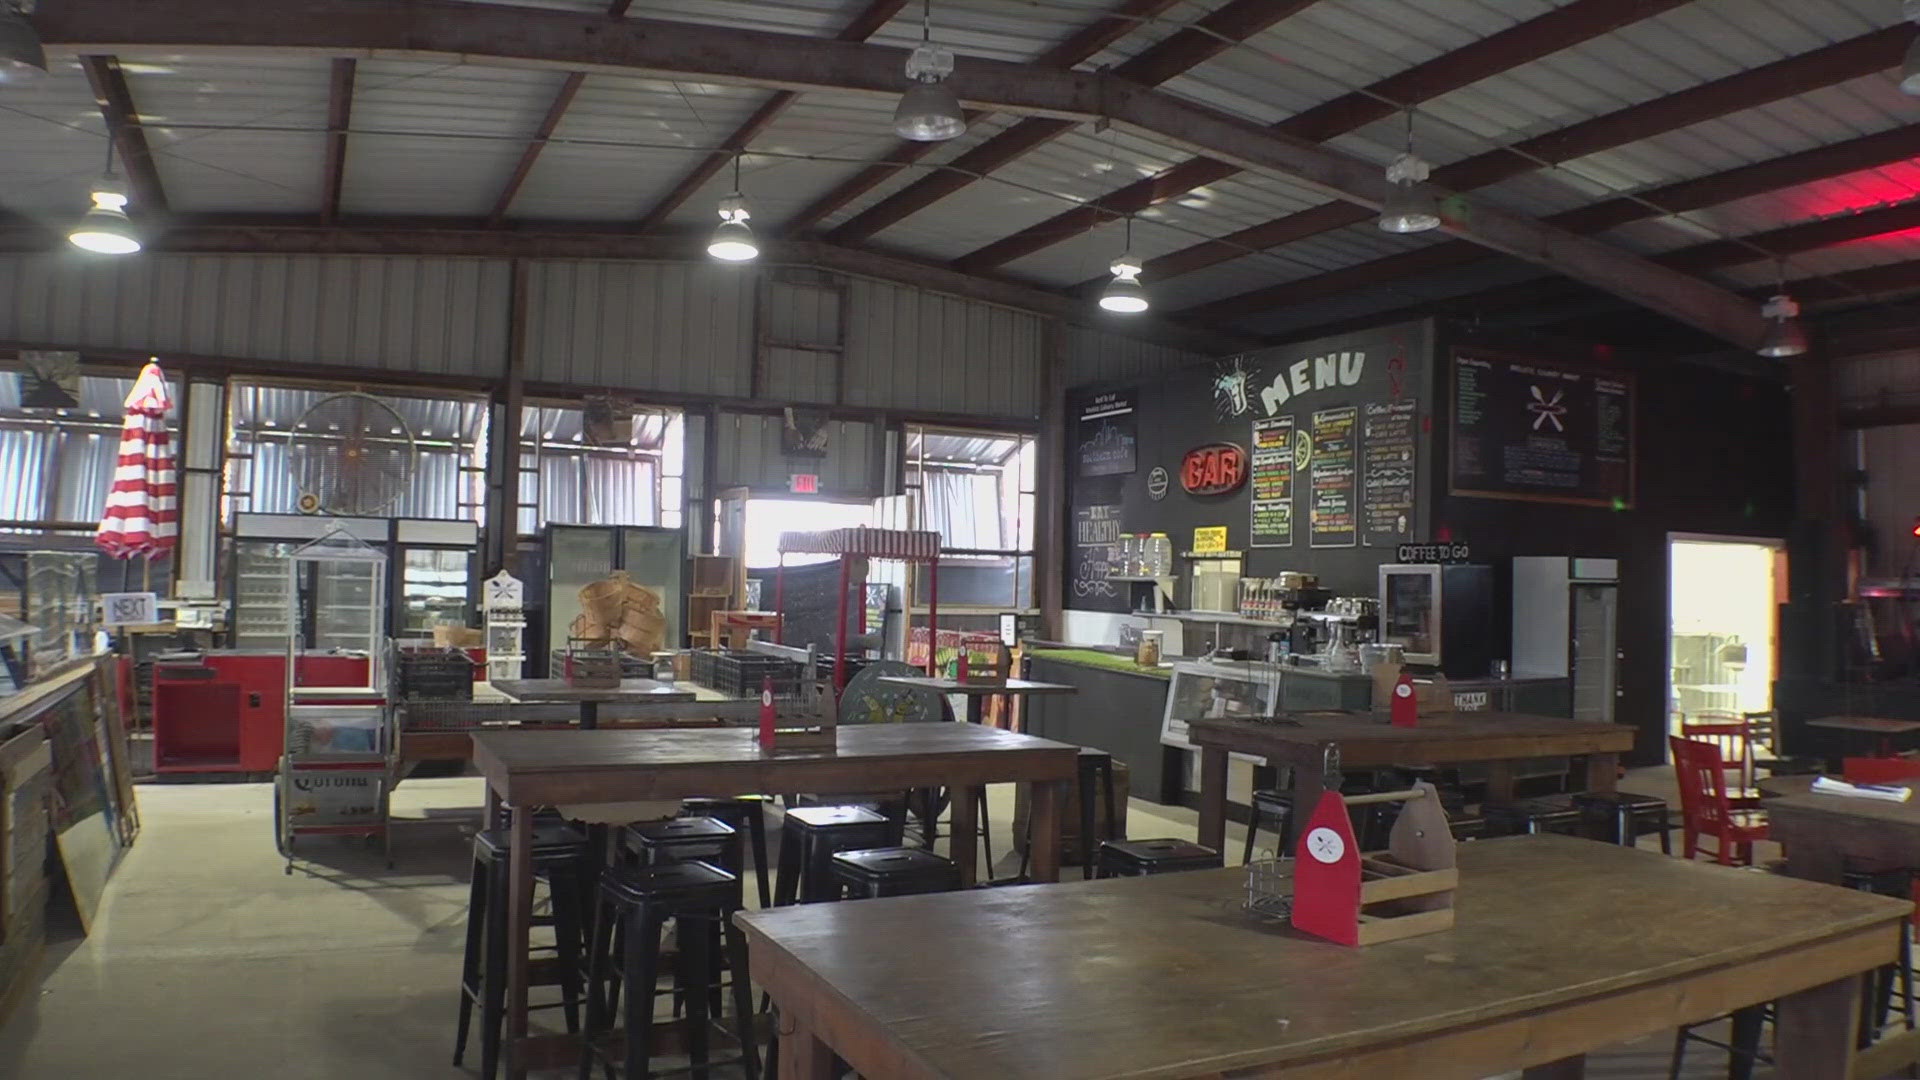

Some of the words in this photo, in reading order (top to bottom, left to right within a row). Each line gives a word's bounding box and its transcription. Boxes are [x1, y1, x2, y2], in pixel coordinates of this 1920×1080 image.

[1260, 351, 1366, 417] MENU
[1186, 448, 1237, 488] BAR
[1399, 545, 1437, 561] COFFEE
[1438, 545, 1450, 559] TO
[1452, 545, 1469, 558] GO
[113, 598, 146, 616] NEXT
